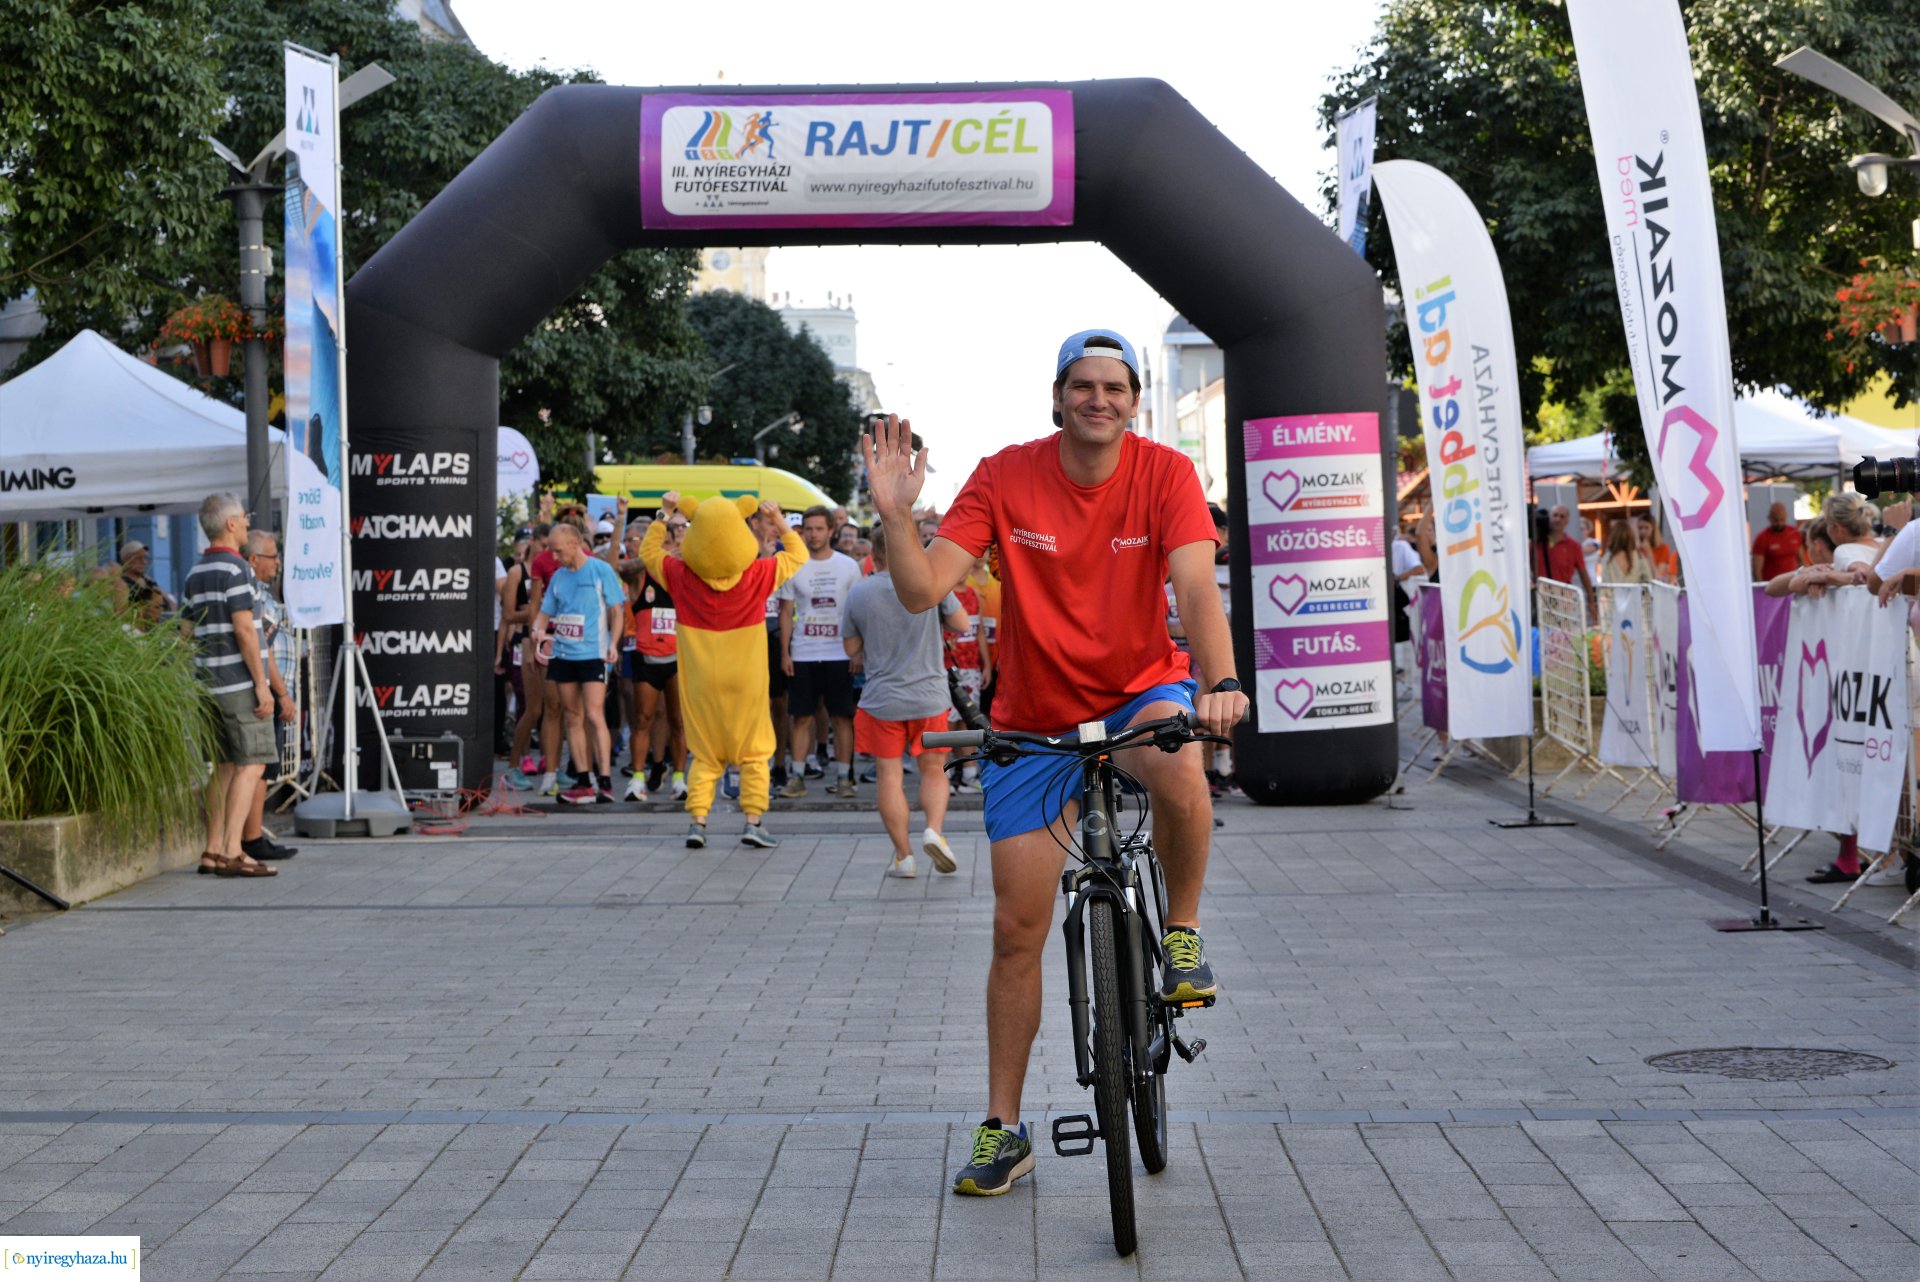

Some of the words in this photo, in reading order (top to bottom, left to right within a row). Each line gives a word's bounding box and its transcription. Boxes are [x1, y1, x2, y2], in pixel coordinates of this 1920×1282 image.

[804, 110, 1039, 158] RAJT/CÉL
[672, 166, 689, 178] III.
[694, 162, 791, 177] NYÍREGYHÁZI
[675, 178, 788, 193] FUTÓFESZTIVÁL
[810, 177, 1034, 195] www.nyiregyhazifutofesztival.hu
[1272, 421, 1356, 447] ÉLMÉNY.
[351, 453, 470, 476] MYLAPS
[377, 477, 425, 486] SPORTS
[430, 477, 467, 485] TIMING
[1302, 472, 1364, 488] MOZAIK
[1010, 535, 1057, 552] FUTÓFESZTIVÁL
[1013, 528, 1056, 543] NYÍREGYHÁZI
[1120, 536, 1149, 546] MOZAIK
[1267, 525, 1371, 552] KÖZÖSSÉG.
[353, 568, 470, 591] MYLAPS
[1309, 576, 1371, 592] MOZAIK
[377, 593, 425, 601] SPORTS
[430, 592, 467, 600] TIMING
[1308, 601, 1362, 613] DEBRECEN
[808, 625, 835, 636] 5195
[1292, 630, 1360, 656] FUTÁS.
[1314, 680, 1376, 697] MOZAIK
[431, 707, 468, 716] TIMING
